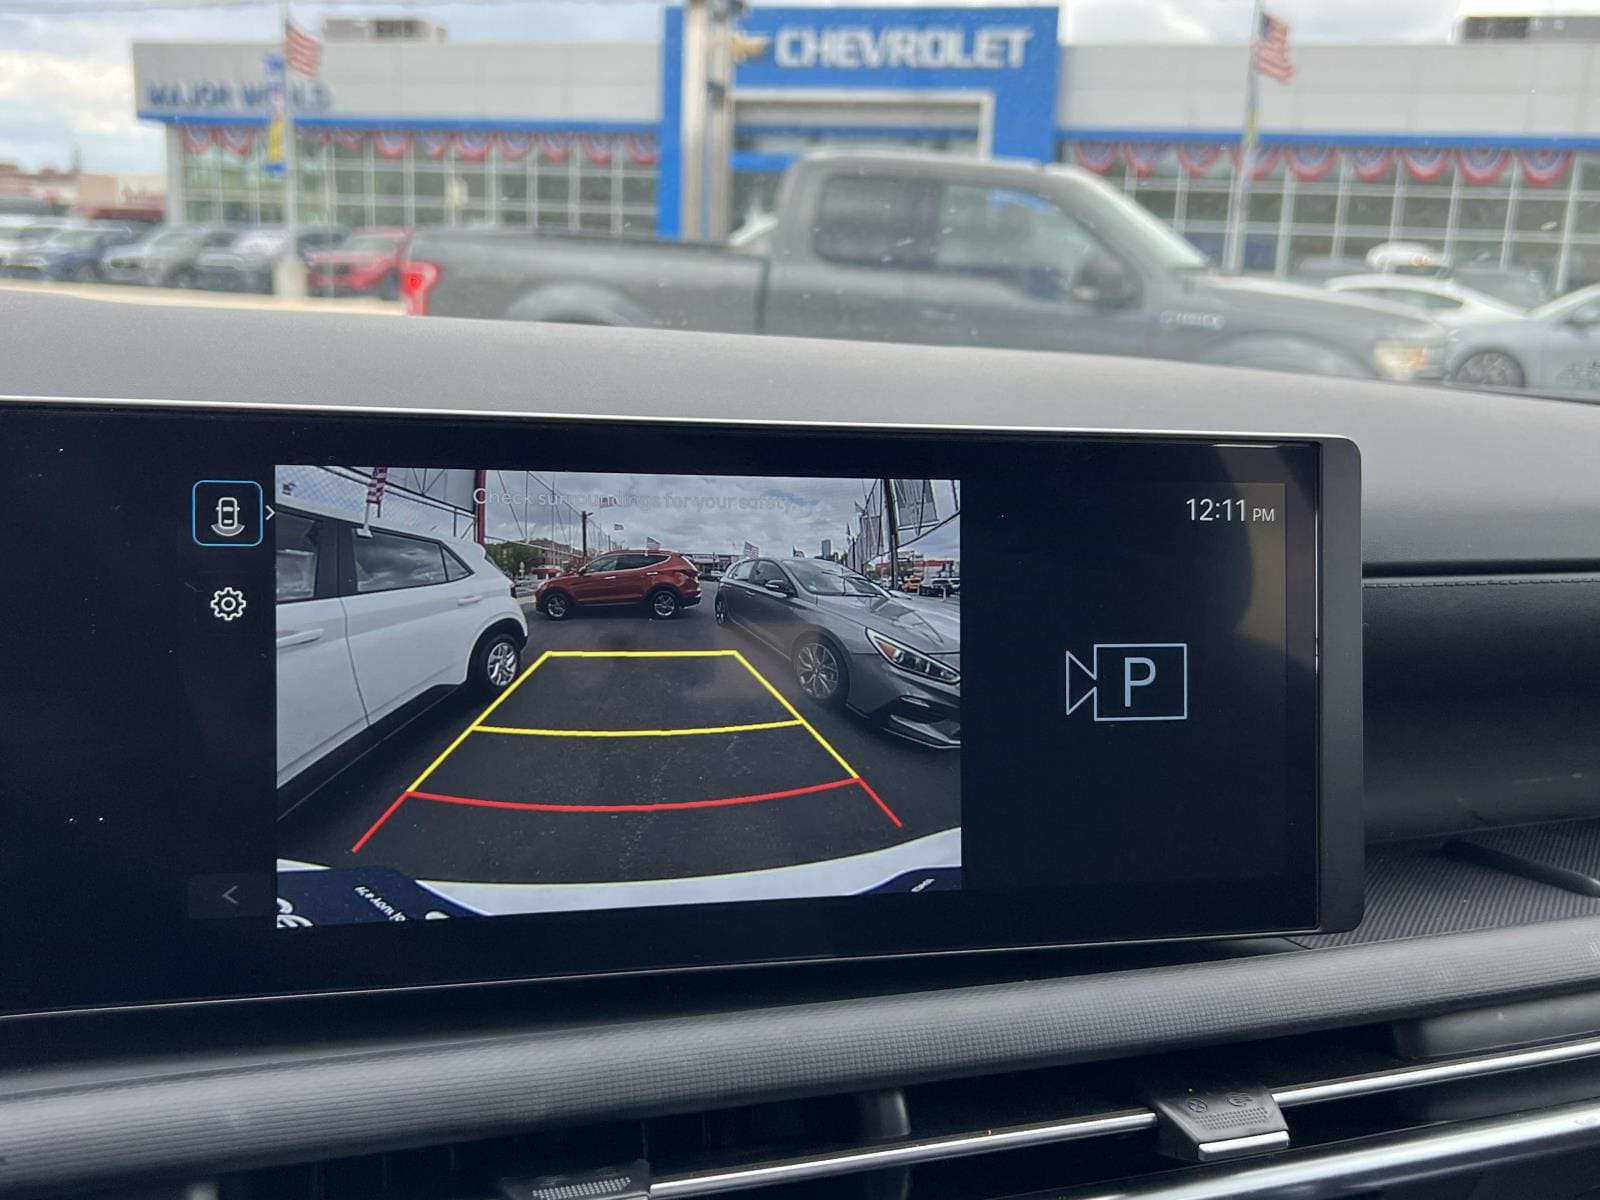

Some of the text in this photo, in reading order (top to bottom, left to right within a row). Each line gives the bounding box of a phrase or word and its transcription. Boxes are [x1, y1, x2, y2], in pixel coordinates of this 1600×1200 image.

[775, 27, 1029, 69] CHEVROLET
[147, 82, 333, 110] MAJOR WLD
[473, 487, 532, 505] Check
[538, 487, 661, 511] surroundings
[665, 491, 692, 509] for
[694, 494, 737, 513] your
[1186, 498, 1275, 522] 12:11 PM
[1124, 656, 1157, 707] P
